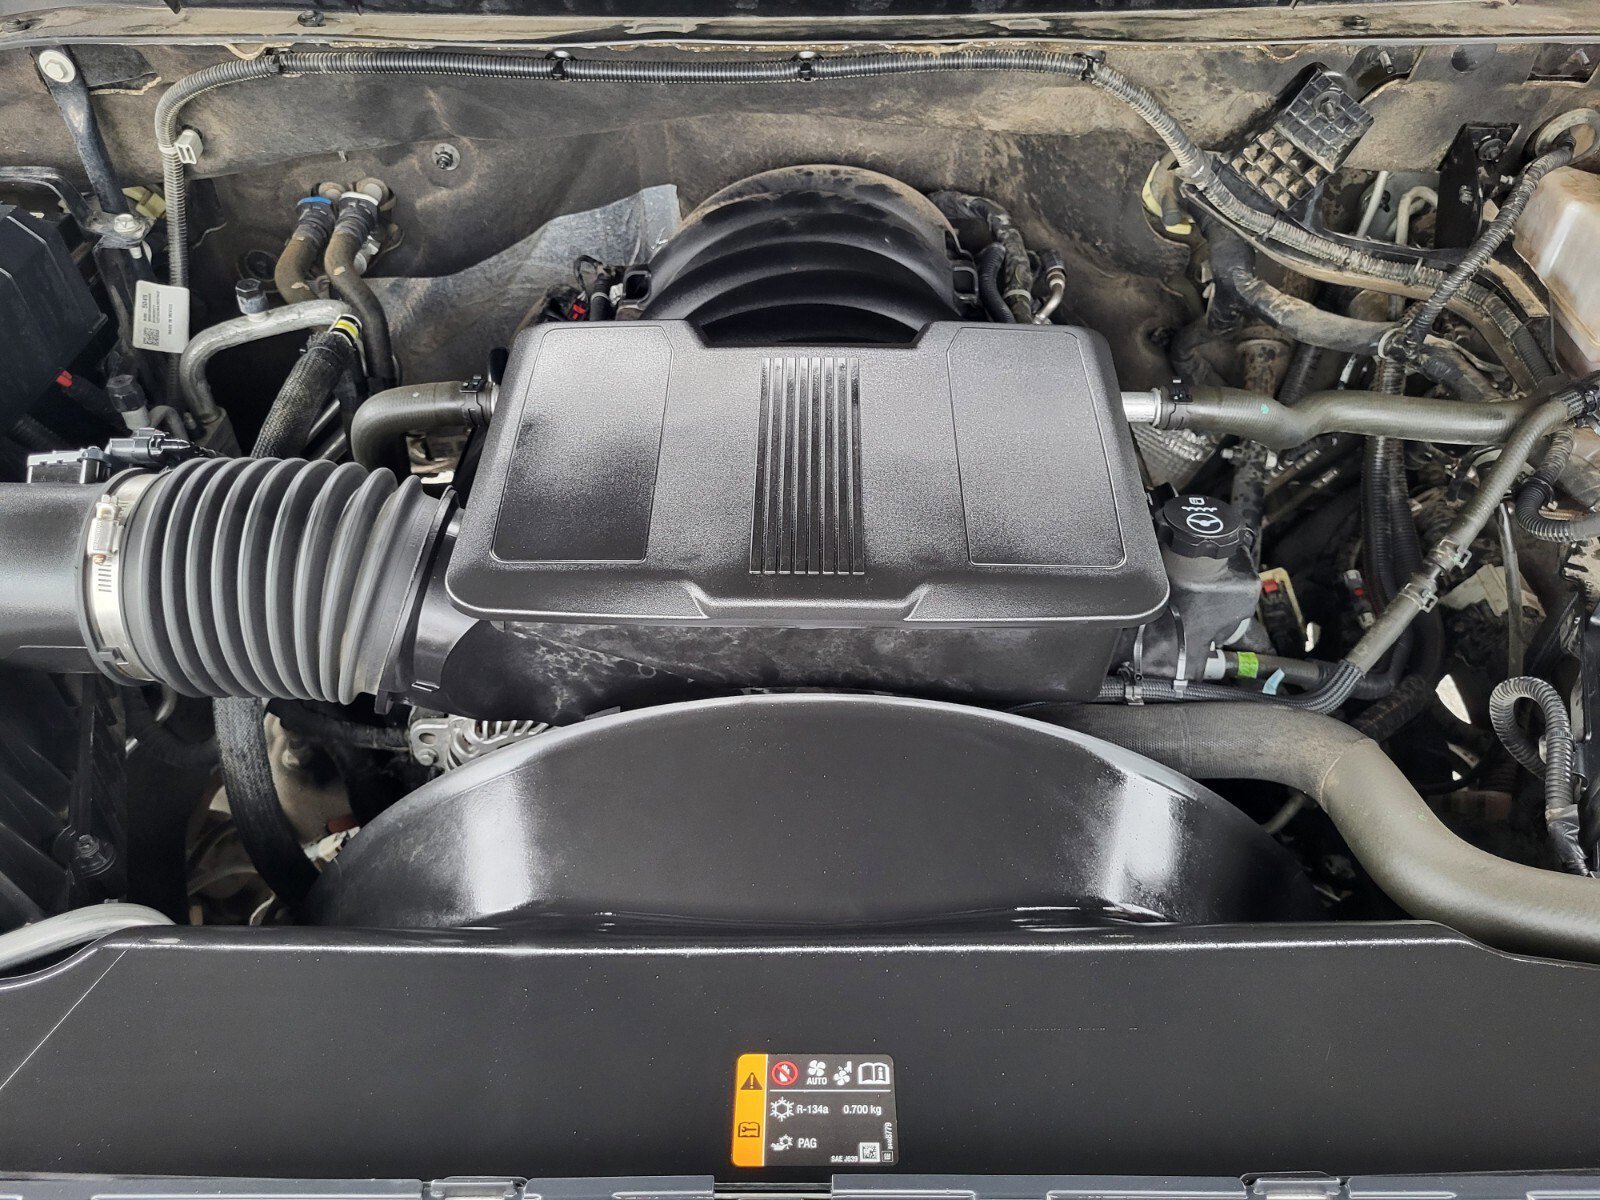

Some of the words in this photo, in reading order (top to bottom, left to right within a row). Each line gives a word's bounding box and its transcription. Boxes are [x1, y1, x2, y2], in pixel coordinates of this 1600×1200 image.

[806, 1077, 827, 1085] AUTO
[796, 1104, 829, 1114] R-134a
[843, 1104, 868, 1114] 0.700
[870, 1104, 882, 1116] kg
[798, 1138, 817, 1148] PAG
